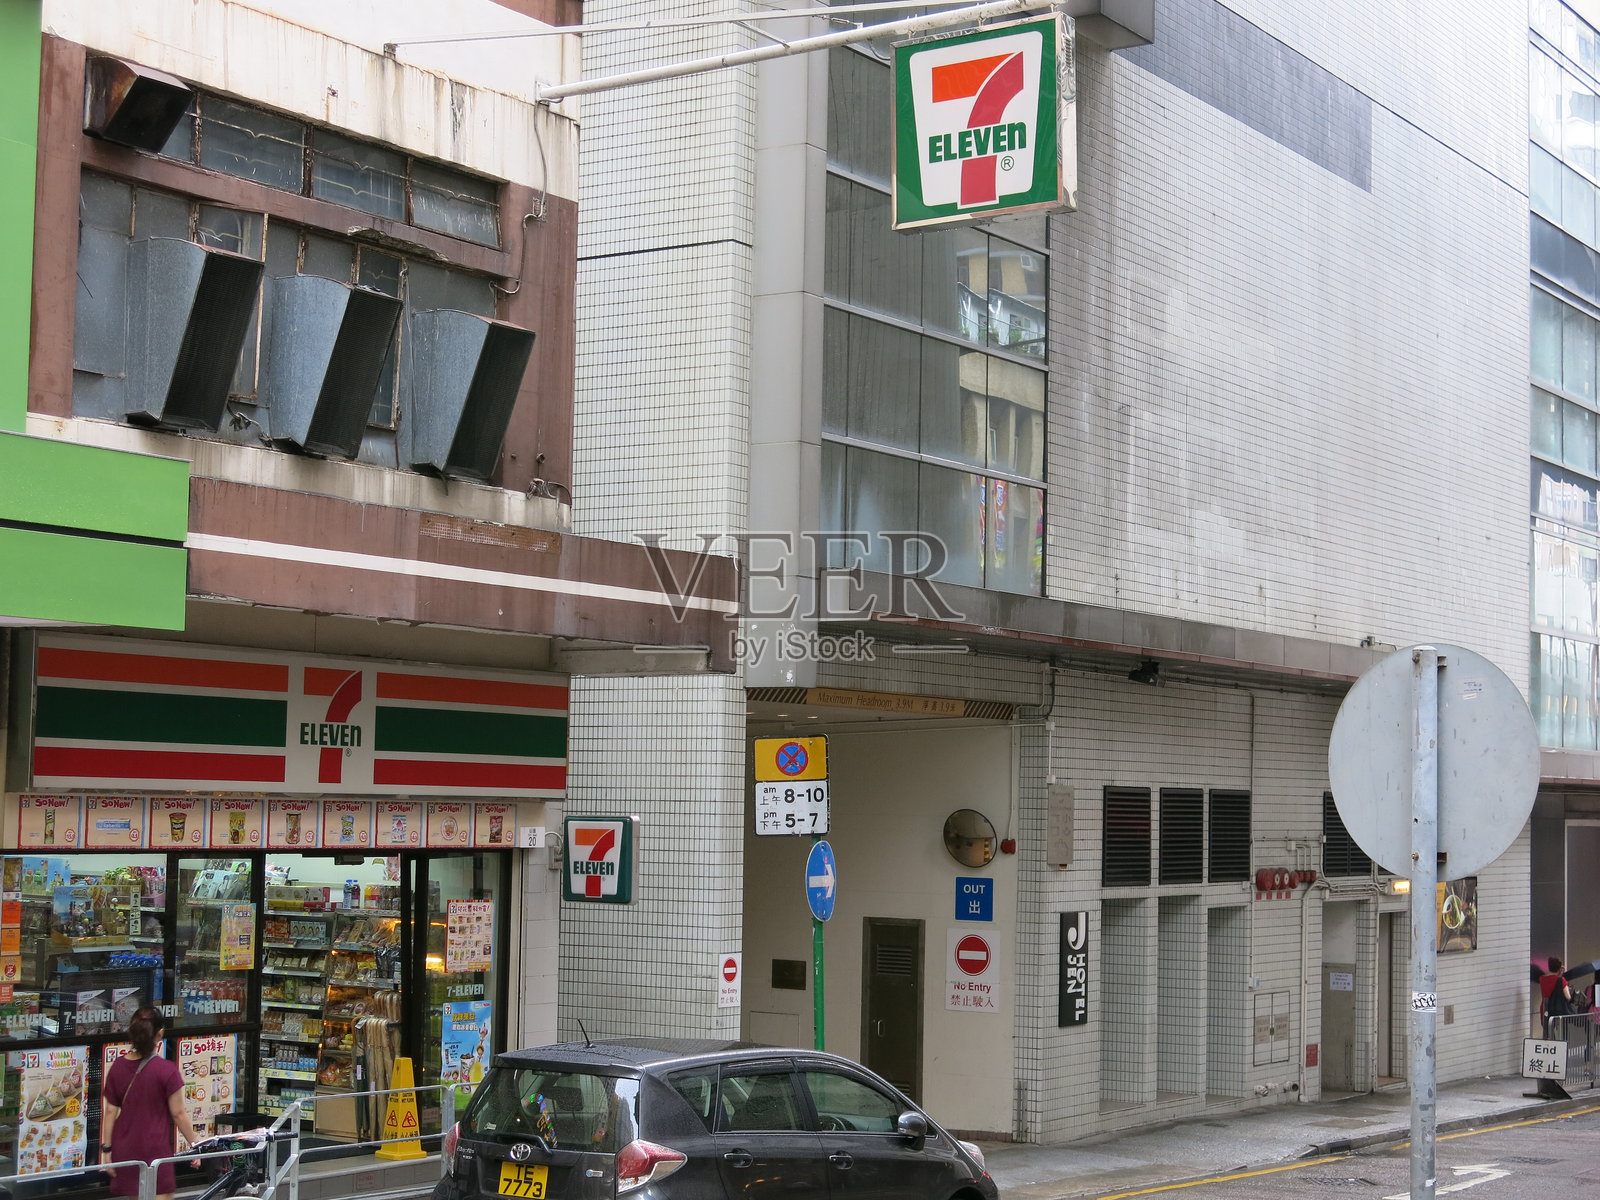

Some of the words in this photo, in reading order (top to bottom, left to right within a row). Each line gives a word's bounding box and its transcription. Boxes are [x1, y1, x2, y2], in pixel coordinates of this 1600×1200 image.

[932, 51, 1024, 206] 7
[818, 692, 852, 705] Maximum
[303, 667, 362, 784] 7
[760, 795, 781, 805] 上午
[784, 788, 825, 803] 8-10
[763, 811, 777, 819] pm
[760, 820, 781, 830] 下午
[528, 836, 537, 847] 20
[963, 884, 985, 894] OUT
[969, 899, 980, 914] 出
[1068, 911, 1086, 950] J
[1067, 955, 1077, 994] JEN
[953, 983, 965, 991] No
[968, 982, 992, 994] Entry
[1075, 953, 1086, 1021] HOTEL
[1535, 1044, 1557, 1054] End
[1529, 1058, 1561, 1074] 終止
[515, 1164, 534, 1182] TE
[502, 1178, 543, 1197] 7773
